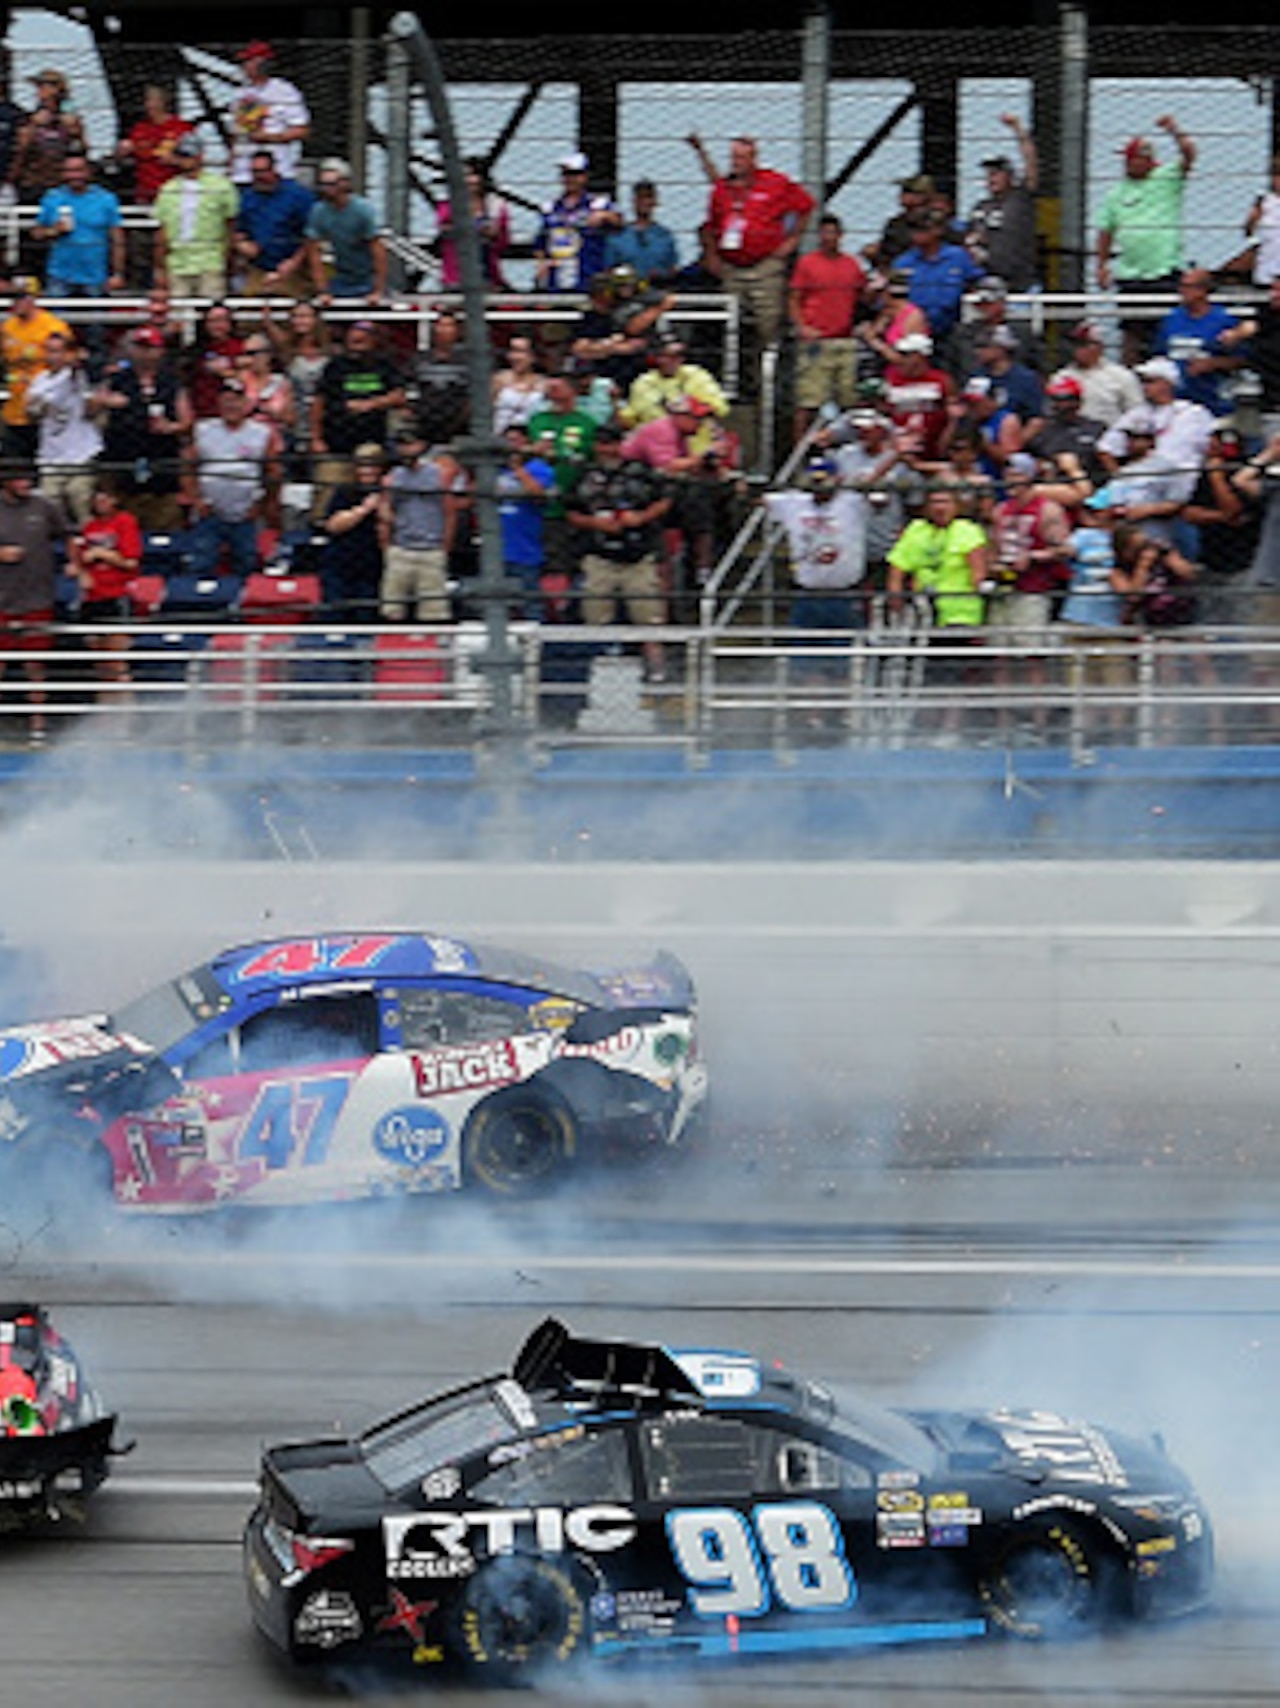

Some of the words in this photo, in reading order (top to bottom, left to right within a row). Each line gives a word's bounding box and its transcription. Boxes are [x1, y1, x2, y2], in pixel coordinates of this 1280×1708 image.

[230, 933, 400, 984] 47
[418, 1051, 513, 1094] JACK
[235, 1072, 357, 1172] 47
[381, 1504, 638, 1560] RTIC
[664, 1501, 858, 1616] 98
